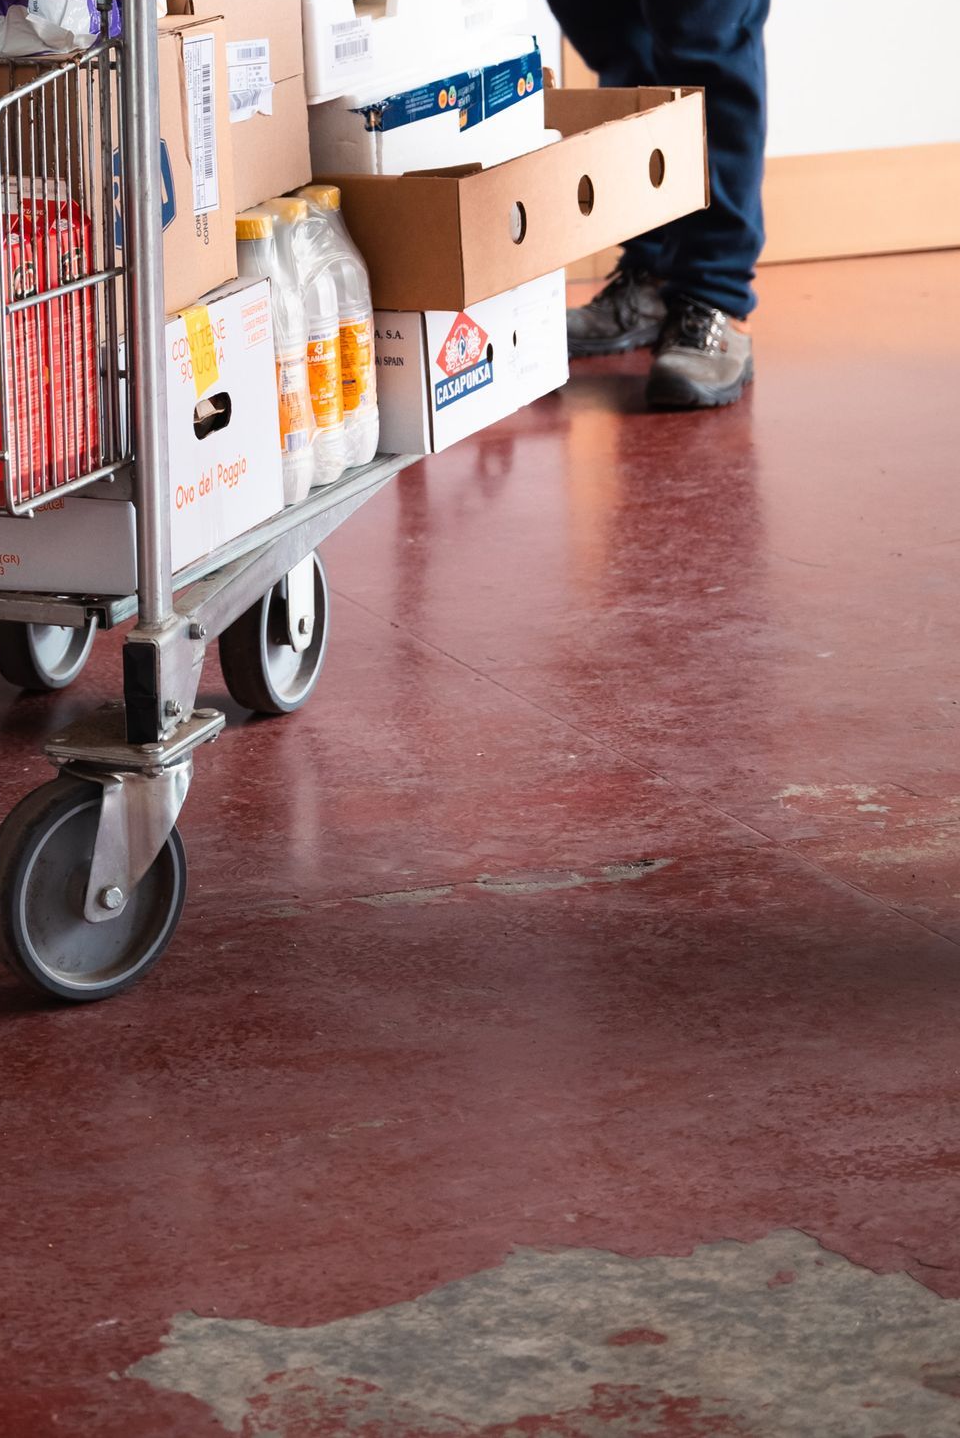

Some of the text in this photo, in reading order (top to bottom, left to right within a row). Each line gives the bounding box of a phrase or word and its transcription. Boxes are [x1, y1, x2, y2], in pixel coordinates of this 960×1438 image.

[171, 318, 226, 362] CONTIENE
[385, 329, 405, 340] S.A.
[180, 350, 225, 384] 90 UOVA
[383, 356, 405, 367] SPAIN
[436, 362, 492, 405] CASAPONSA
[175, 454, 248, 510] Ovo del Poggio
[0, 554, 21, 566] (GR)
